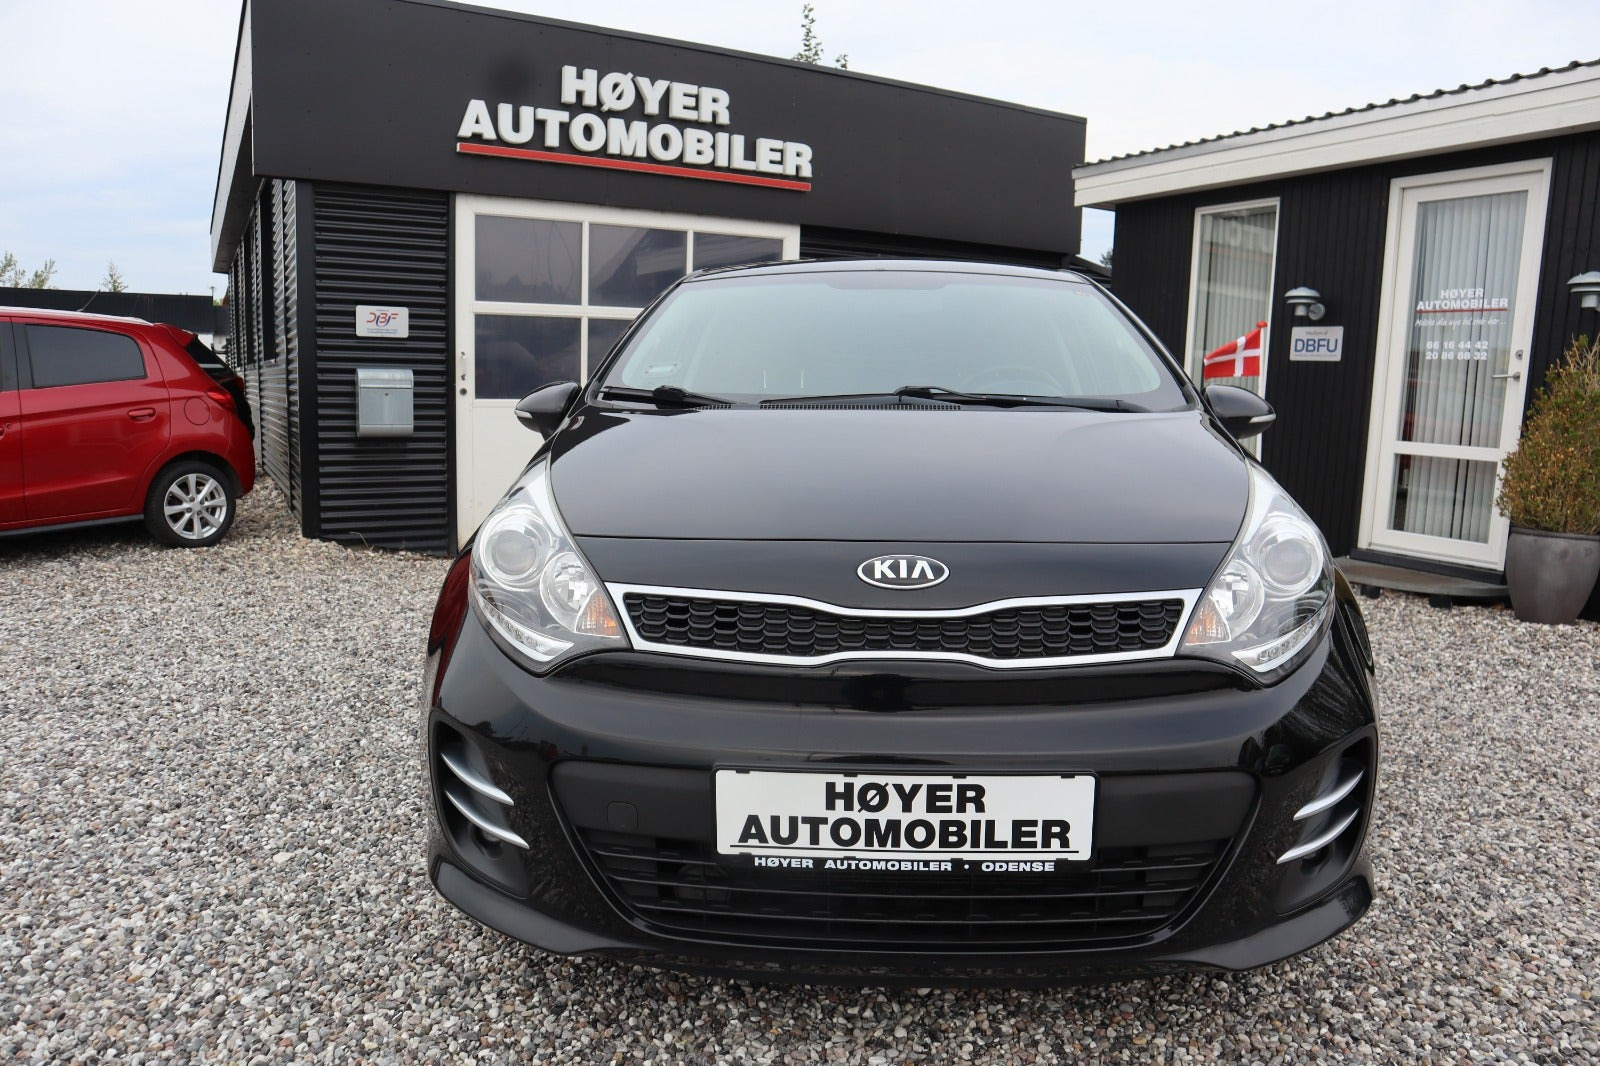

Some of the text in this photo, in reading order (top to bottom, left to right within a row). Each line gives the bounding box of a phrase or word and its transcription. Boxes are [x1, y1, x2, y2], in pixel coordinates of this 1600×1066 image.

[561, 65, 731, 125] HØYER
[457, 99, 813, 178] AUTOMOBILER
[1440, 288, 1484, 299] HØYER
[1416, 298, 1508, 310] AUTOMOBILER
[1294, 338, 1338, 352] DBFU
[1443, 341, 1455, 350] 16
[1458, 340, 1471, 350] 44
[1474, 340, 1488, 350] 42
[1425, 352, 1439, 361] 20
[1473, 351, 1488, 361] 32
[873, 559, 935, 579] KIA
[825, 782, 986, 813] HØYER
[738, 815, 1071, 849] AUTOMOBILER
[754, 857, 1055, 872] HØYER AUTOMOBILER ODENSE
